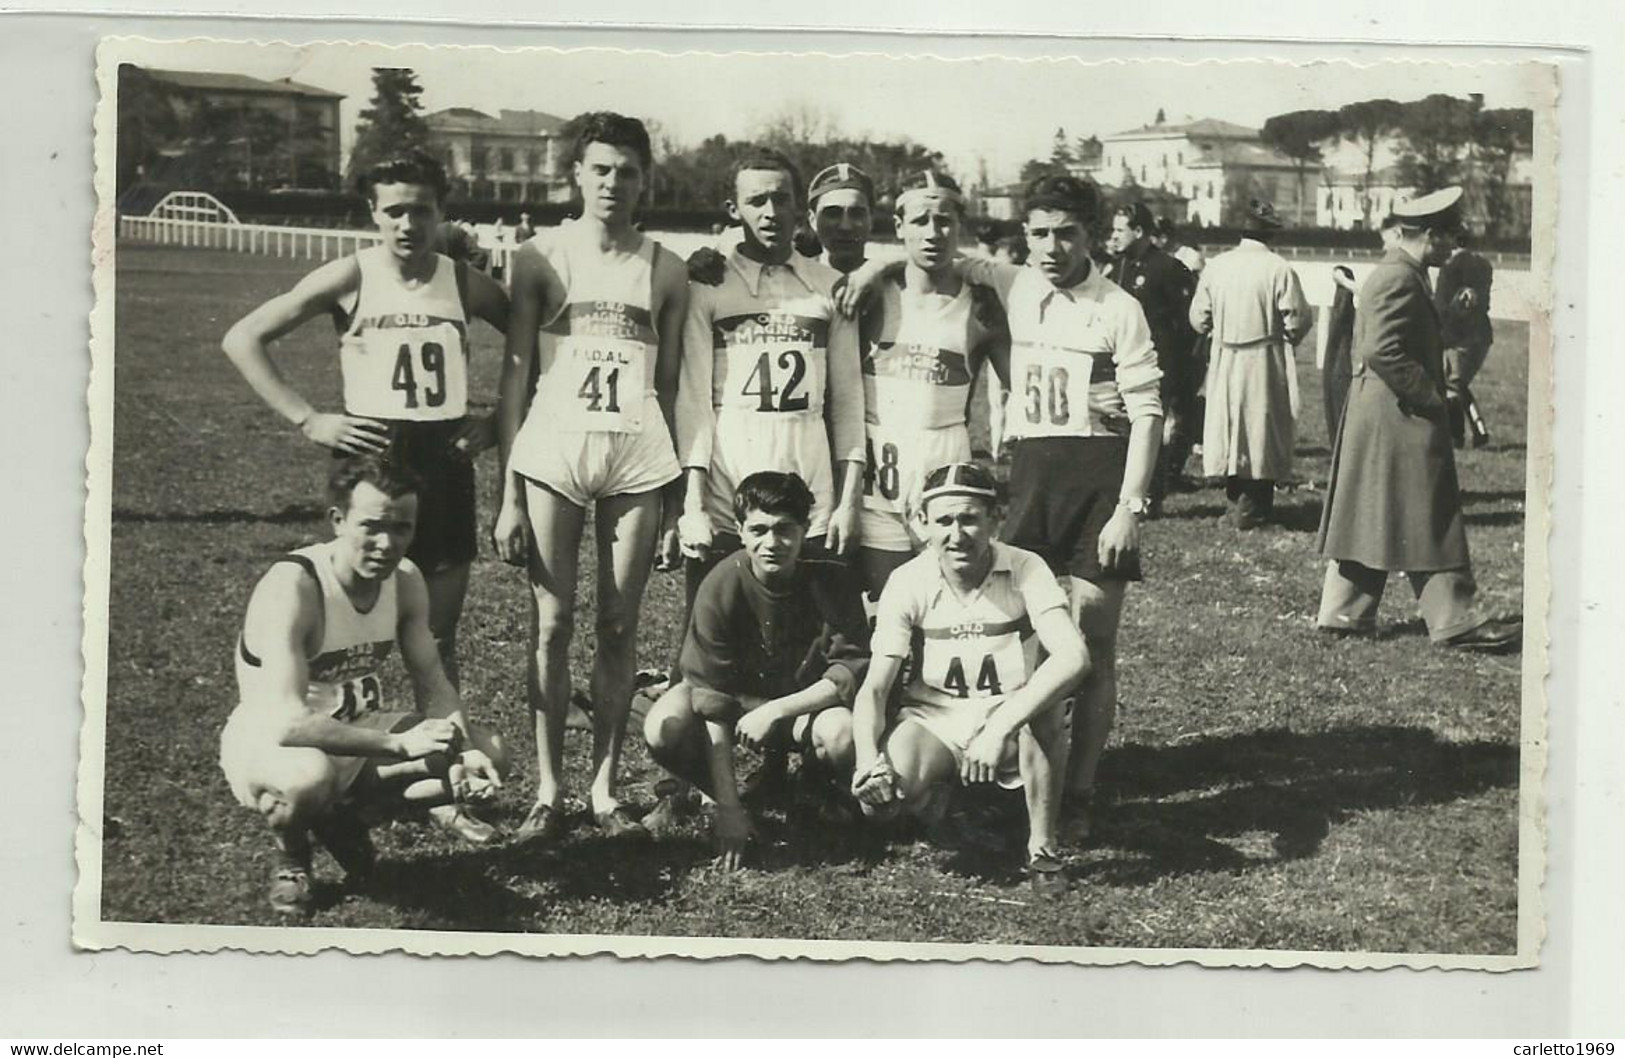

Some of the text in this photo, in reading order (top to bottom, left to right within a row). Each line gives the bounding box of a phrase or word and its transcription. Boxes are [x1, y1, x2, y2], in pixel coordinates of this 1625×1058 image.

[392, 342, 447, 408] 49
[578, 366, 620, 413] 41
[741, 350, 809, 412] 42
[1025, 364, 1070, 426] 50
[944, 654, 1004, 698] 44
